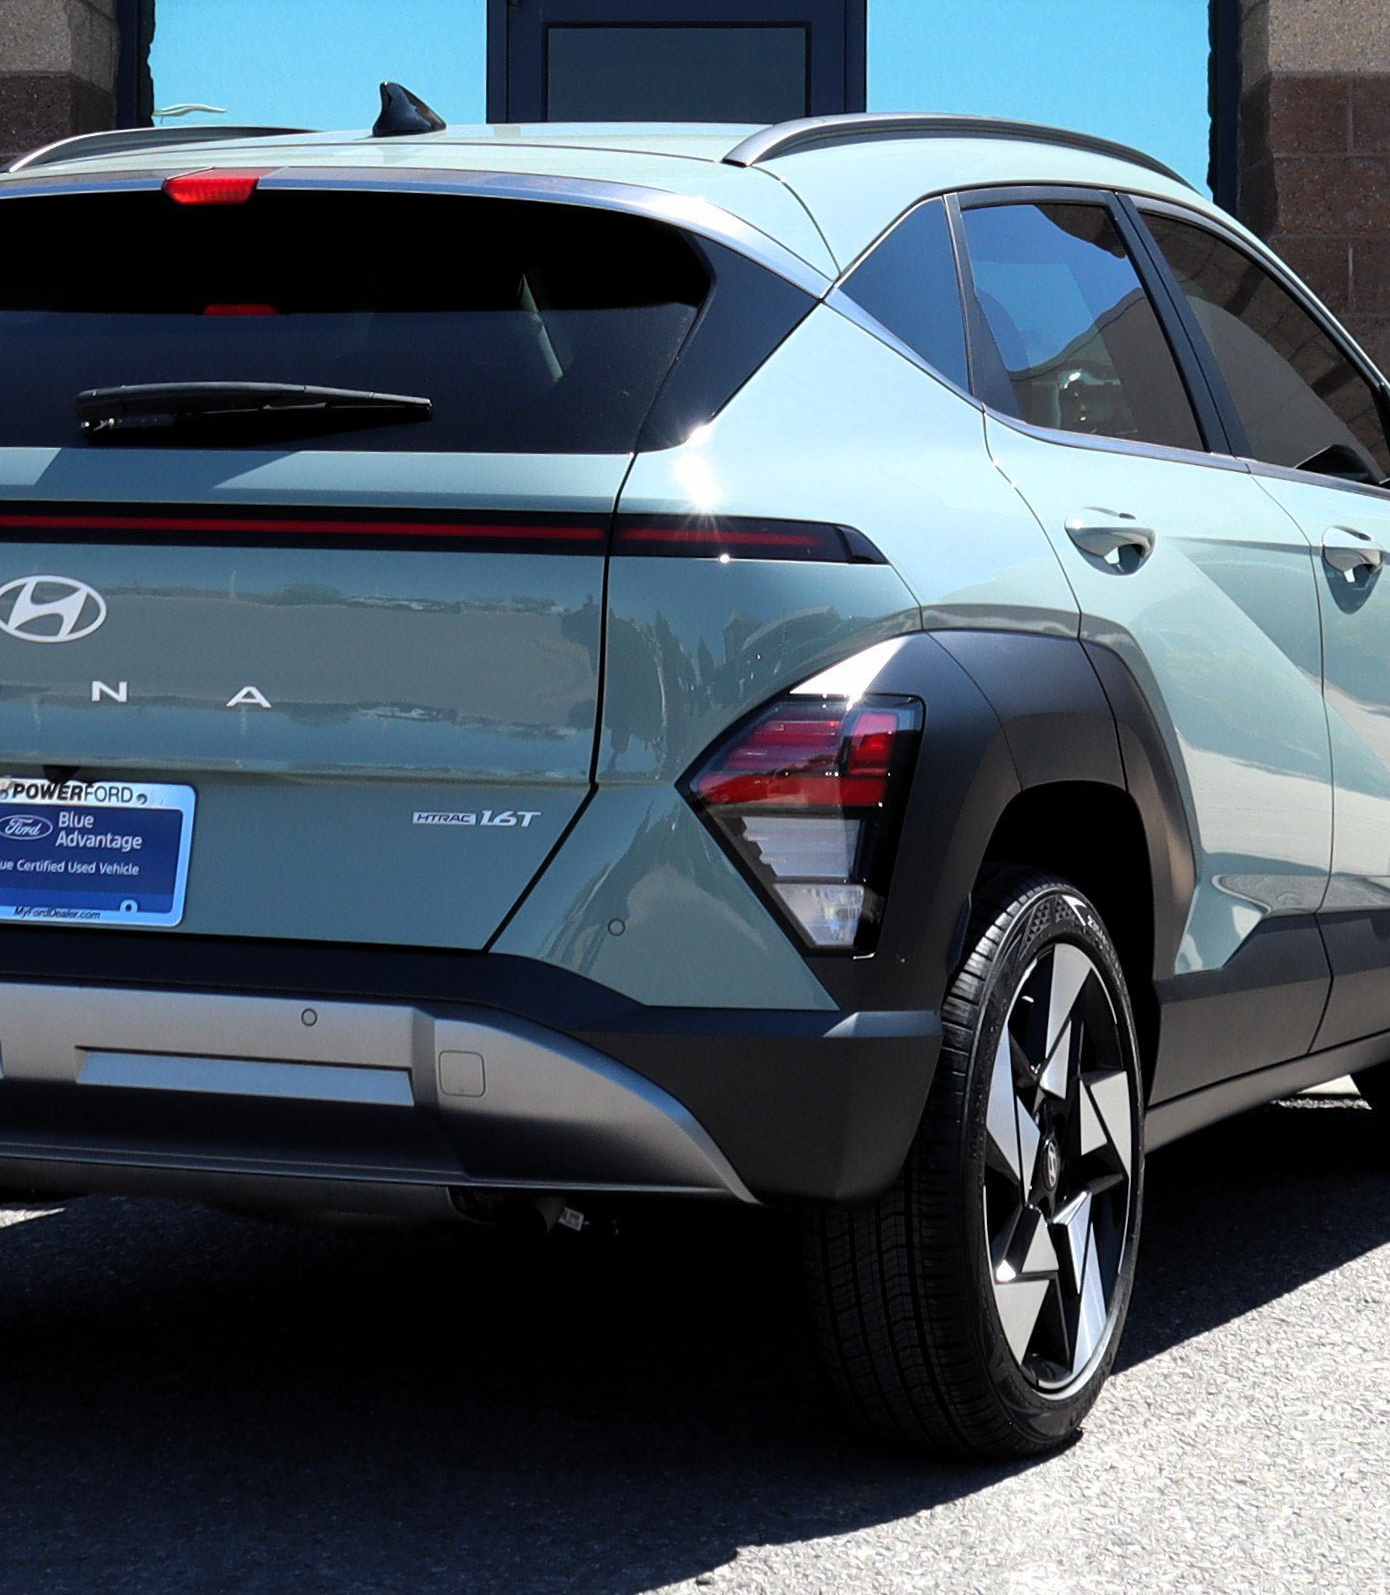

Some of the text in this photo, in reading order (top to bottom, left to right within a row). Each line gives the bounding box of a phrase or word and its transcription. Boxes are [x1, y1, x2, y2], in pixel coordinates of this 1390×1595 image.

[59, 811, 94, 828] Blue
[416, 813, 472, 823] HTRAC
[5, 818, 42, 836] Ford
[55, 830, 143, 852] Advantage
[16, 859, 65, 873] Certified
[67, 861, 96, 873] Used
[99, 862, 139, 876] Vehicle
